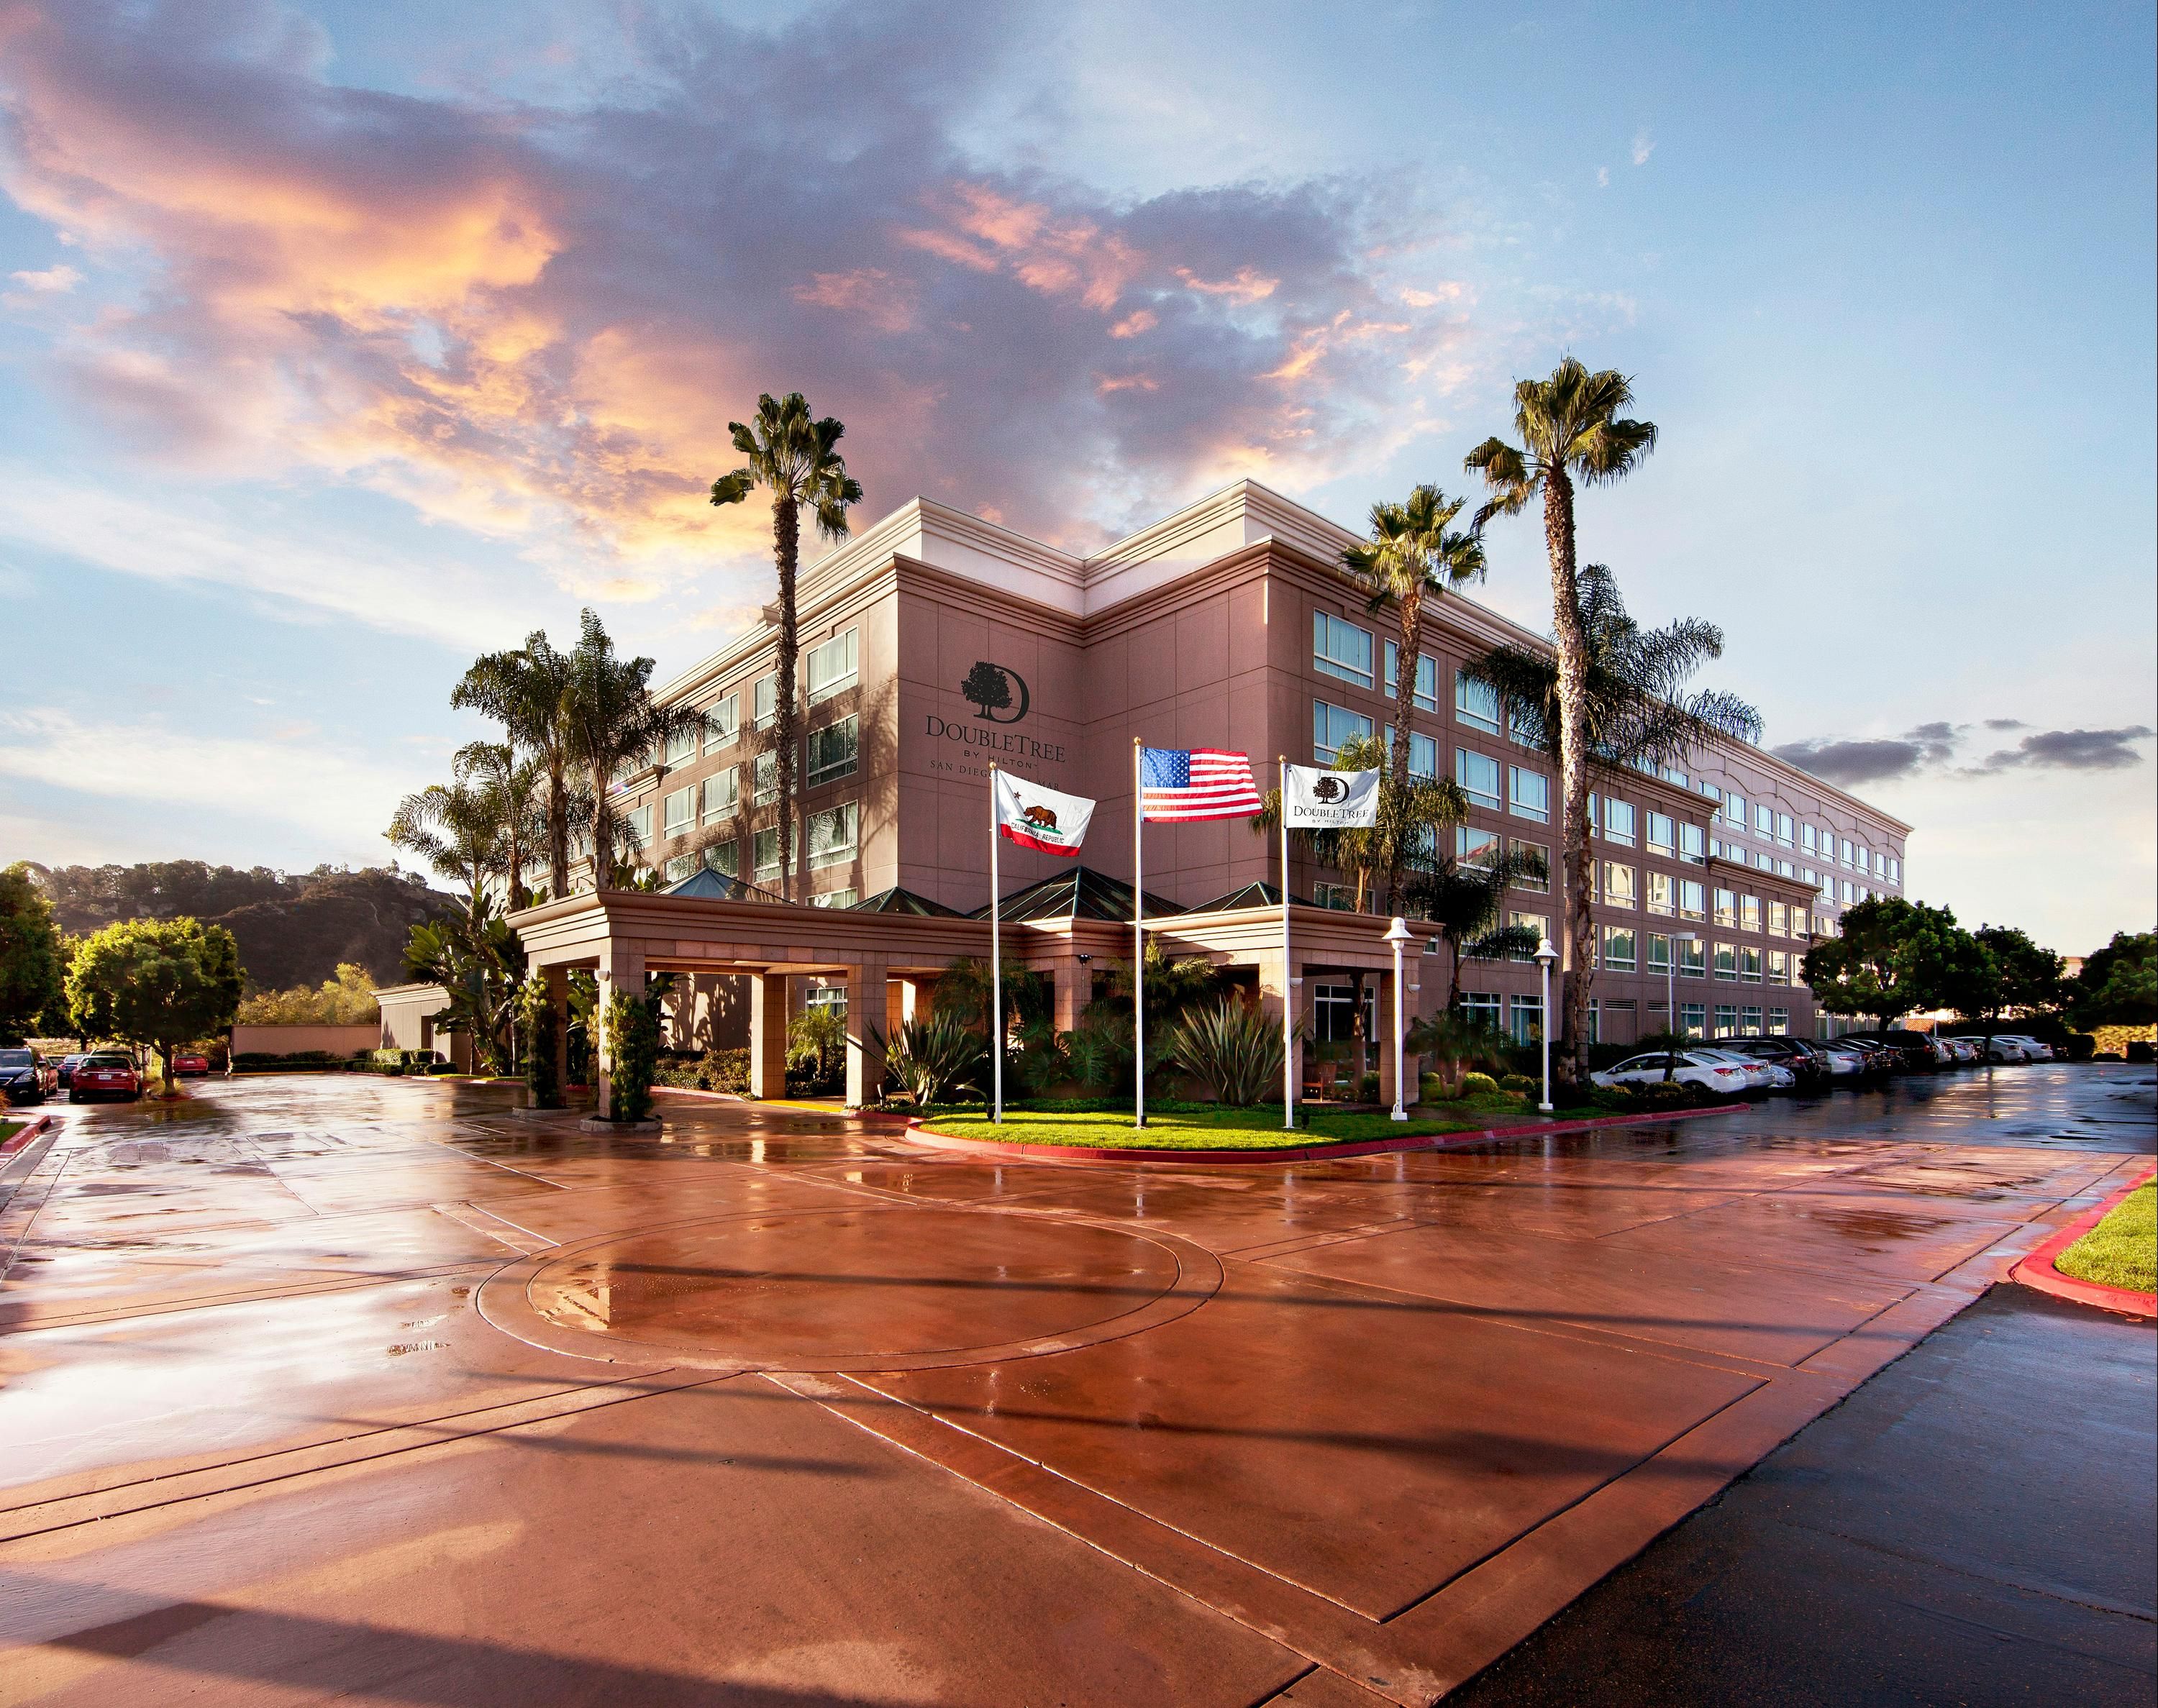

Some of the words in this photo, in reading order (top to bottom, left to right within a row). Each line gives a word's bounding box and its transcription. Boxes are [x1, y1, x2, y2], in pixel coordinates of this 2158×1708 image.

[930, 760, 953, 772] SAN
[963, 749, 980, 758] BY
[988, 754, 1032, 769] HILTON
[1011, 822, 1039, 838] CALIFORNIA
[1042, 834, 1065, 844] REPUBLIC
